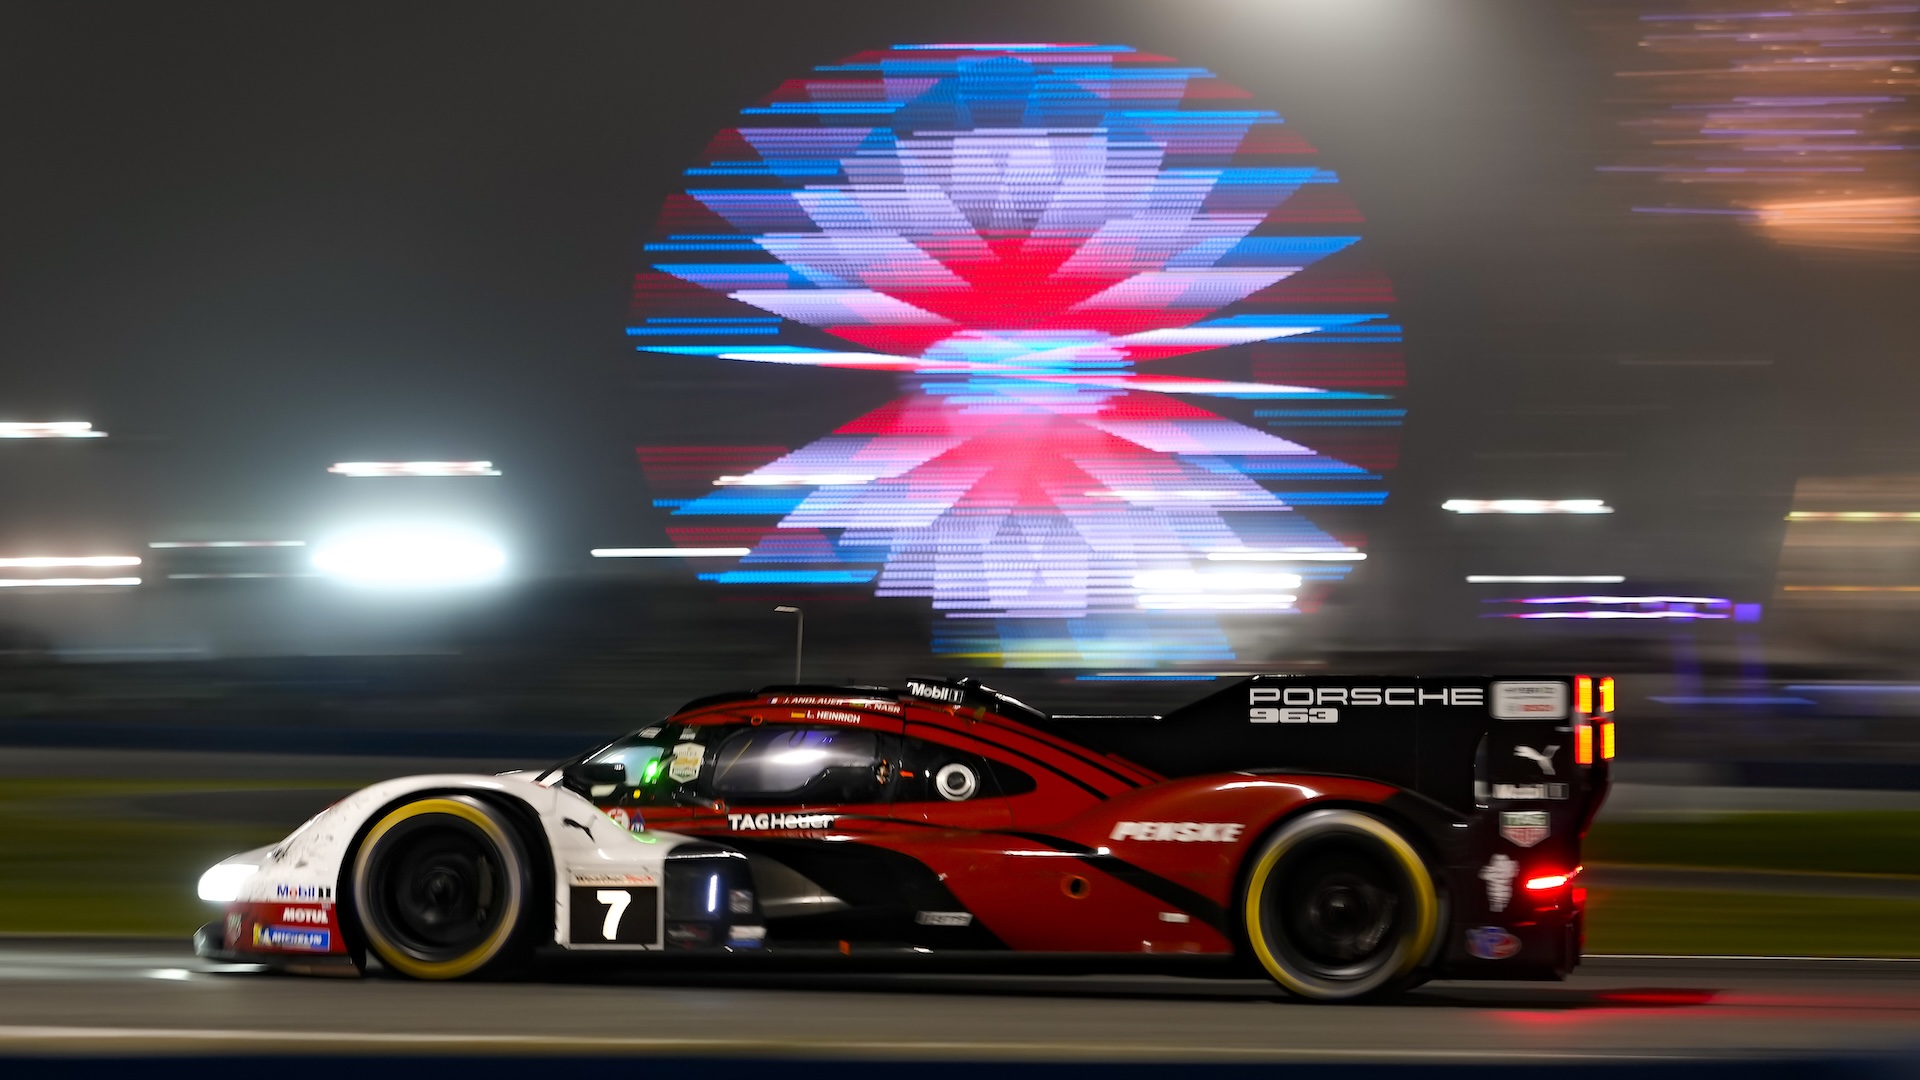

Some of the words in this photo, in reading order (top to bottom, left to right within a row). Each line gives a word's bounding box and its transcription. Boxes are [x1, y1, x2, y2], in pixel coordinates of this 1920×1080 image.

[911, 682, 949, 700] Mobil
[1250, 688, 1483, 706] PORSCHE
[816, 710, 861, 724] HEINRICH
[1250, 708, 1338, 723] 963
[1109, 821, 1246, 843] PENSKE
[276, 884, 315, 899] Mobil
[283, 906, 328, 924] MOTUL
[597, 889, 632, 941] 7
